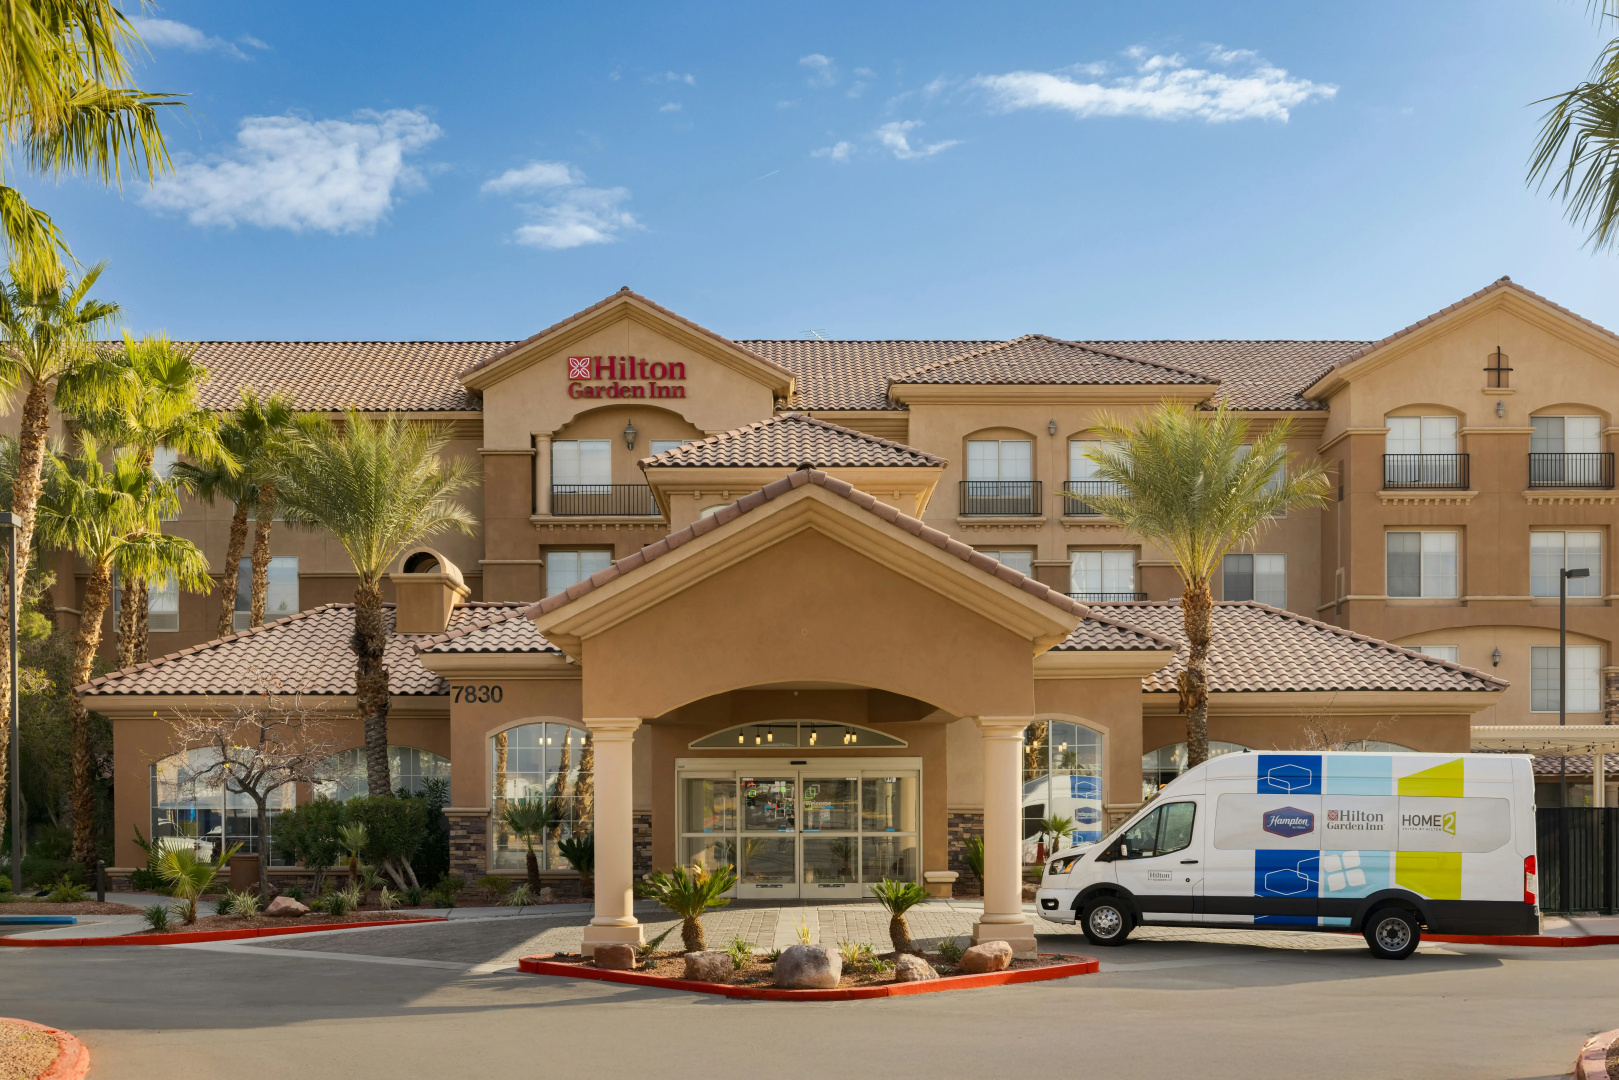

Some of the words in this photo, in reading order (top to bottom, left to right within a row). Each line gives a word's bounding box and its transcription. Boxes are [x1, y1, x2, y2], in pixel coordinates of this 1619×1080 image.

[594, 356, 687, 380] Hilton
[568, 381, 646, 399] Garden
[649, 381, 687, 399] Inn
[452, 685, 503, 703] 7830
[1268, 814, 1309, 827] Hampton
[1340, 810, 1384, 822] Hilton
[1327, 822, 1364, 831] Garden
[1366, 822, 1384, 831] Inn
